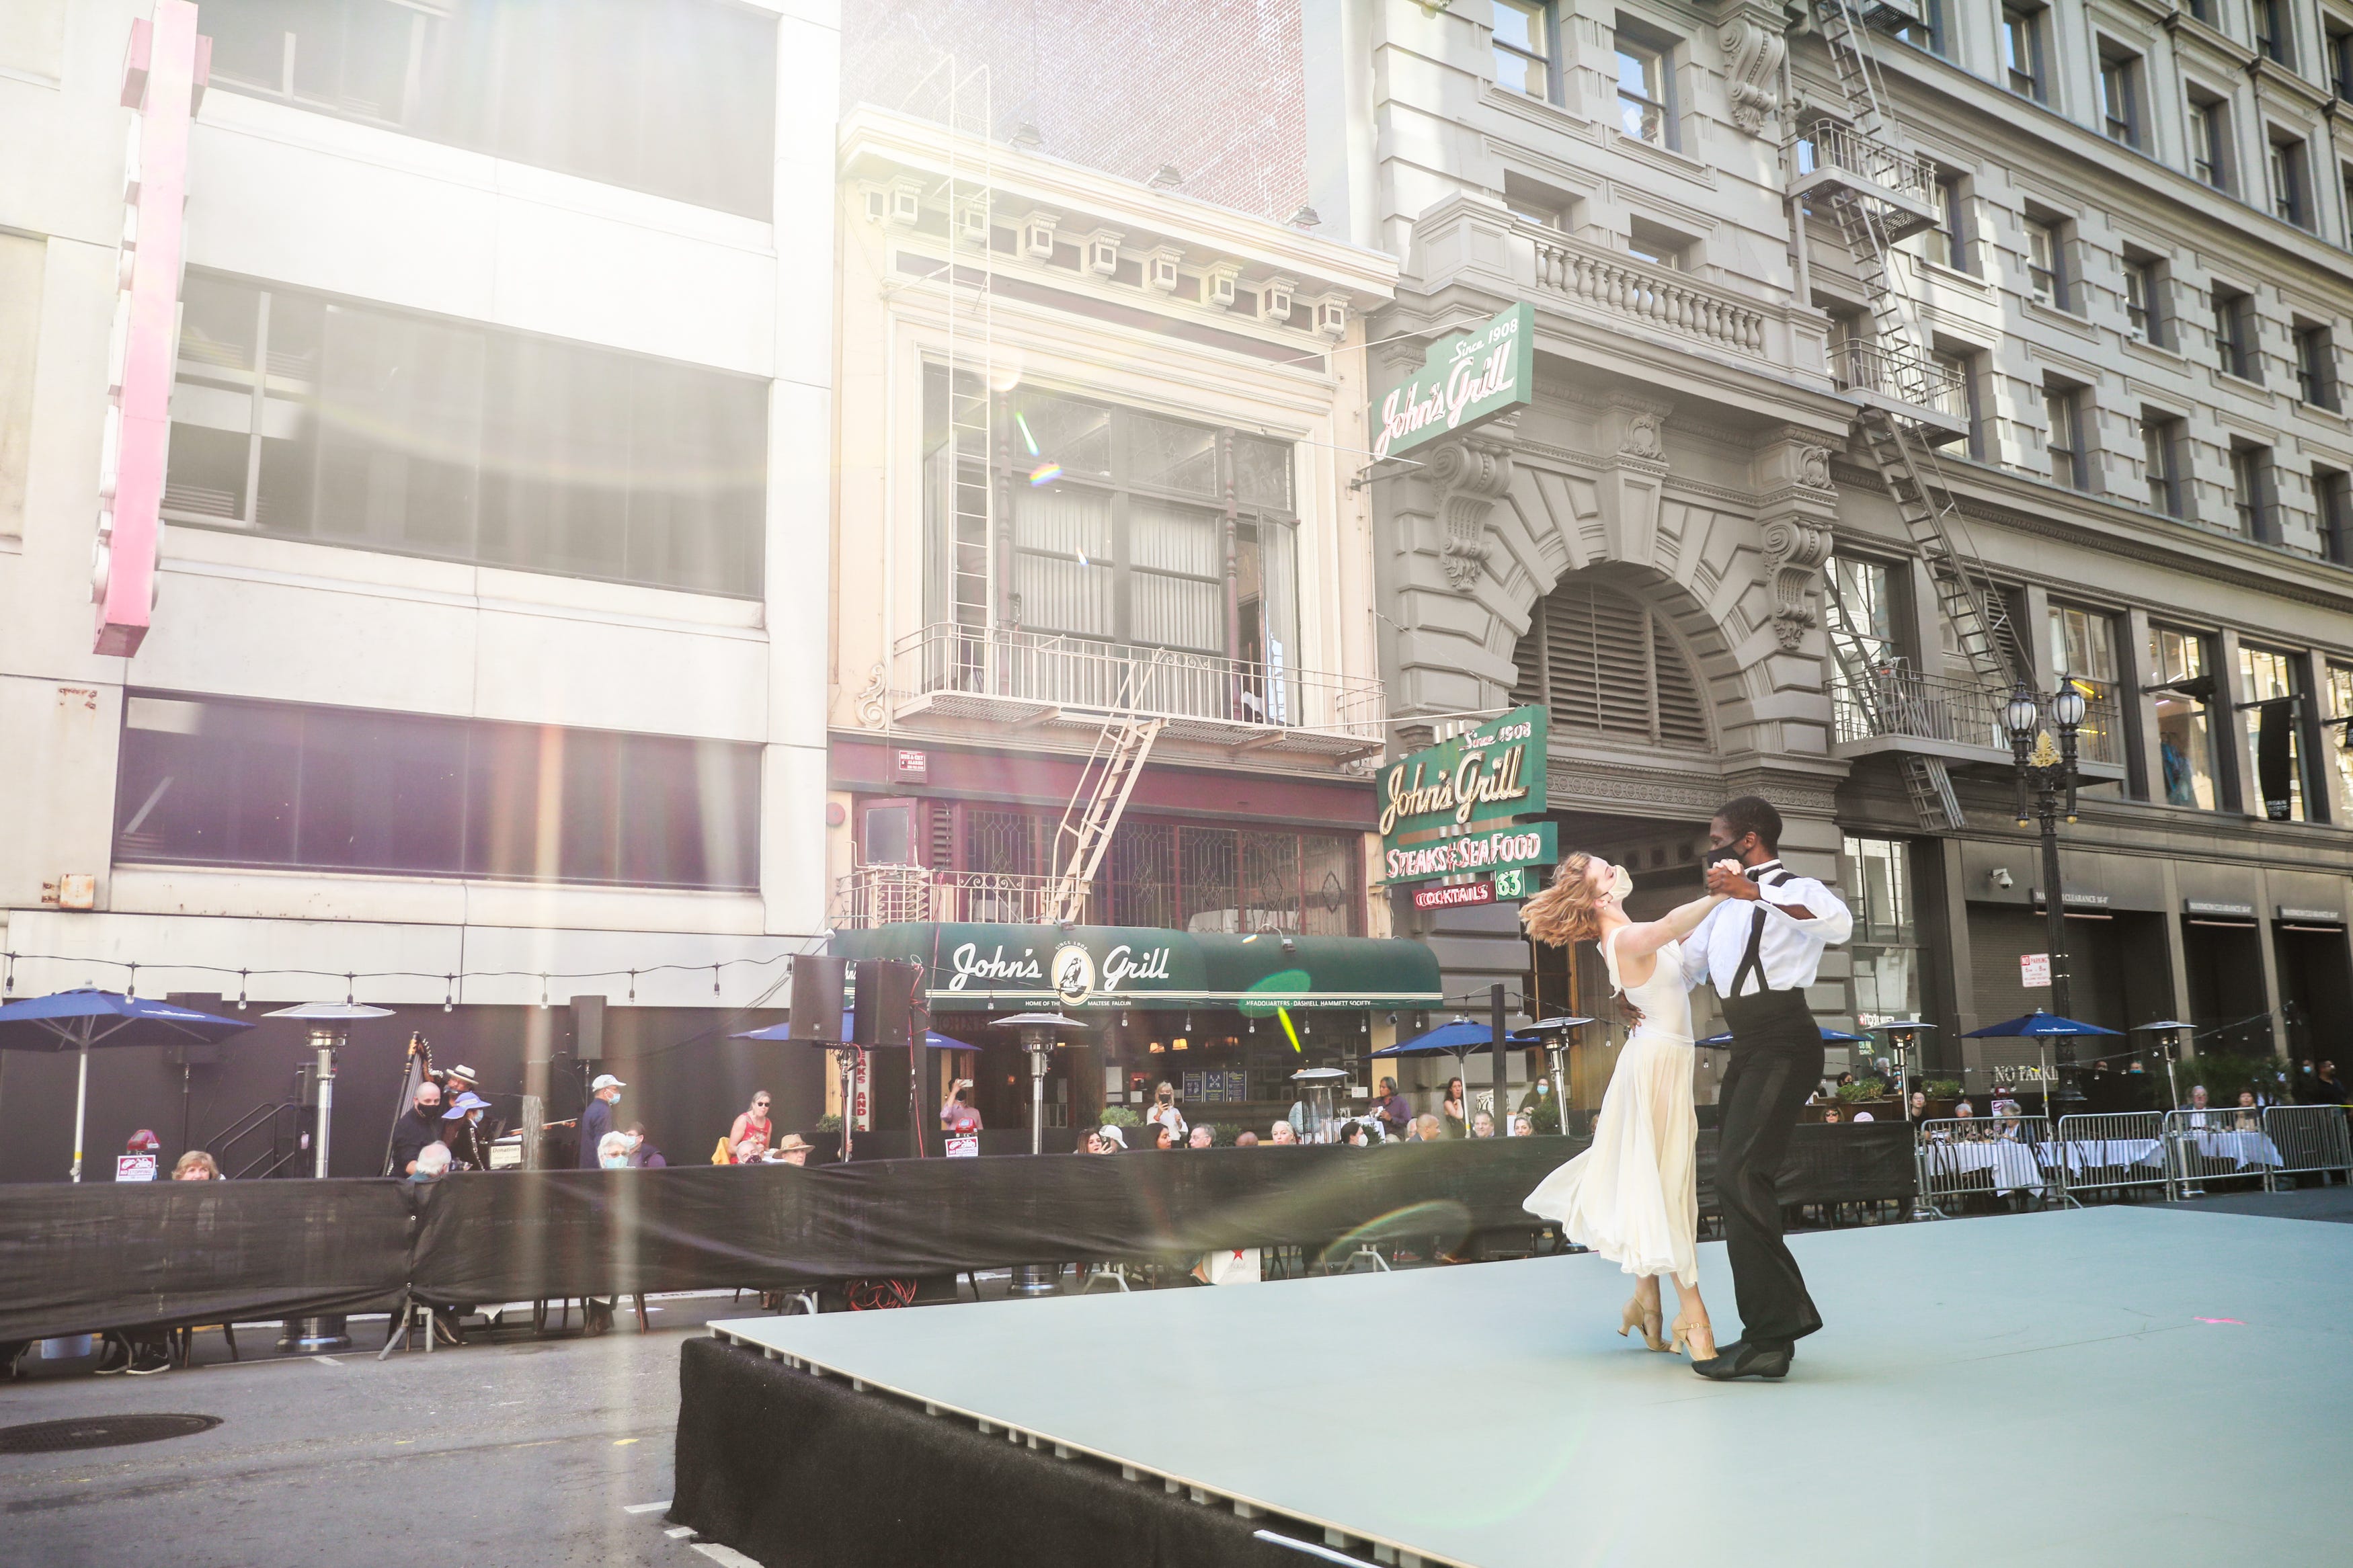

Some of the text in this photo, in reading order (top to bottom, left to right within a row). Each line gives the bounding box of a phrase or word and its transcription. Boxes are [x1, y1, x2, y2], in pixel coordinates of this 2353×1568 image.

[1449, 318, 1518, 363] Since 1908
[1374, 339, 1515, 461] John's Grill
[1459, 722, 1531, 751] Since 1908
[1379, 744, 1529, 836] John's Grill
[1386, 846, 1447, 878] STEAKS
[1416, 884, 1489, 907] COCKTAILS
[1496, 868, 1521, 897] 63
[1055, 940, 1072, 951] SINCE
[949, 942, 1170, 991] John's Grill
[857, 1050, 867, 1084] EAKS
[1994, 1065, 2059, 1082] NO PARKI
[857, 1091, 867, 1116] AND
